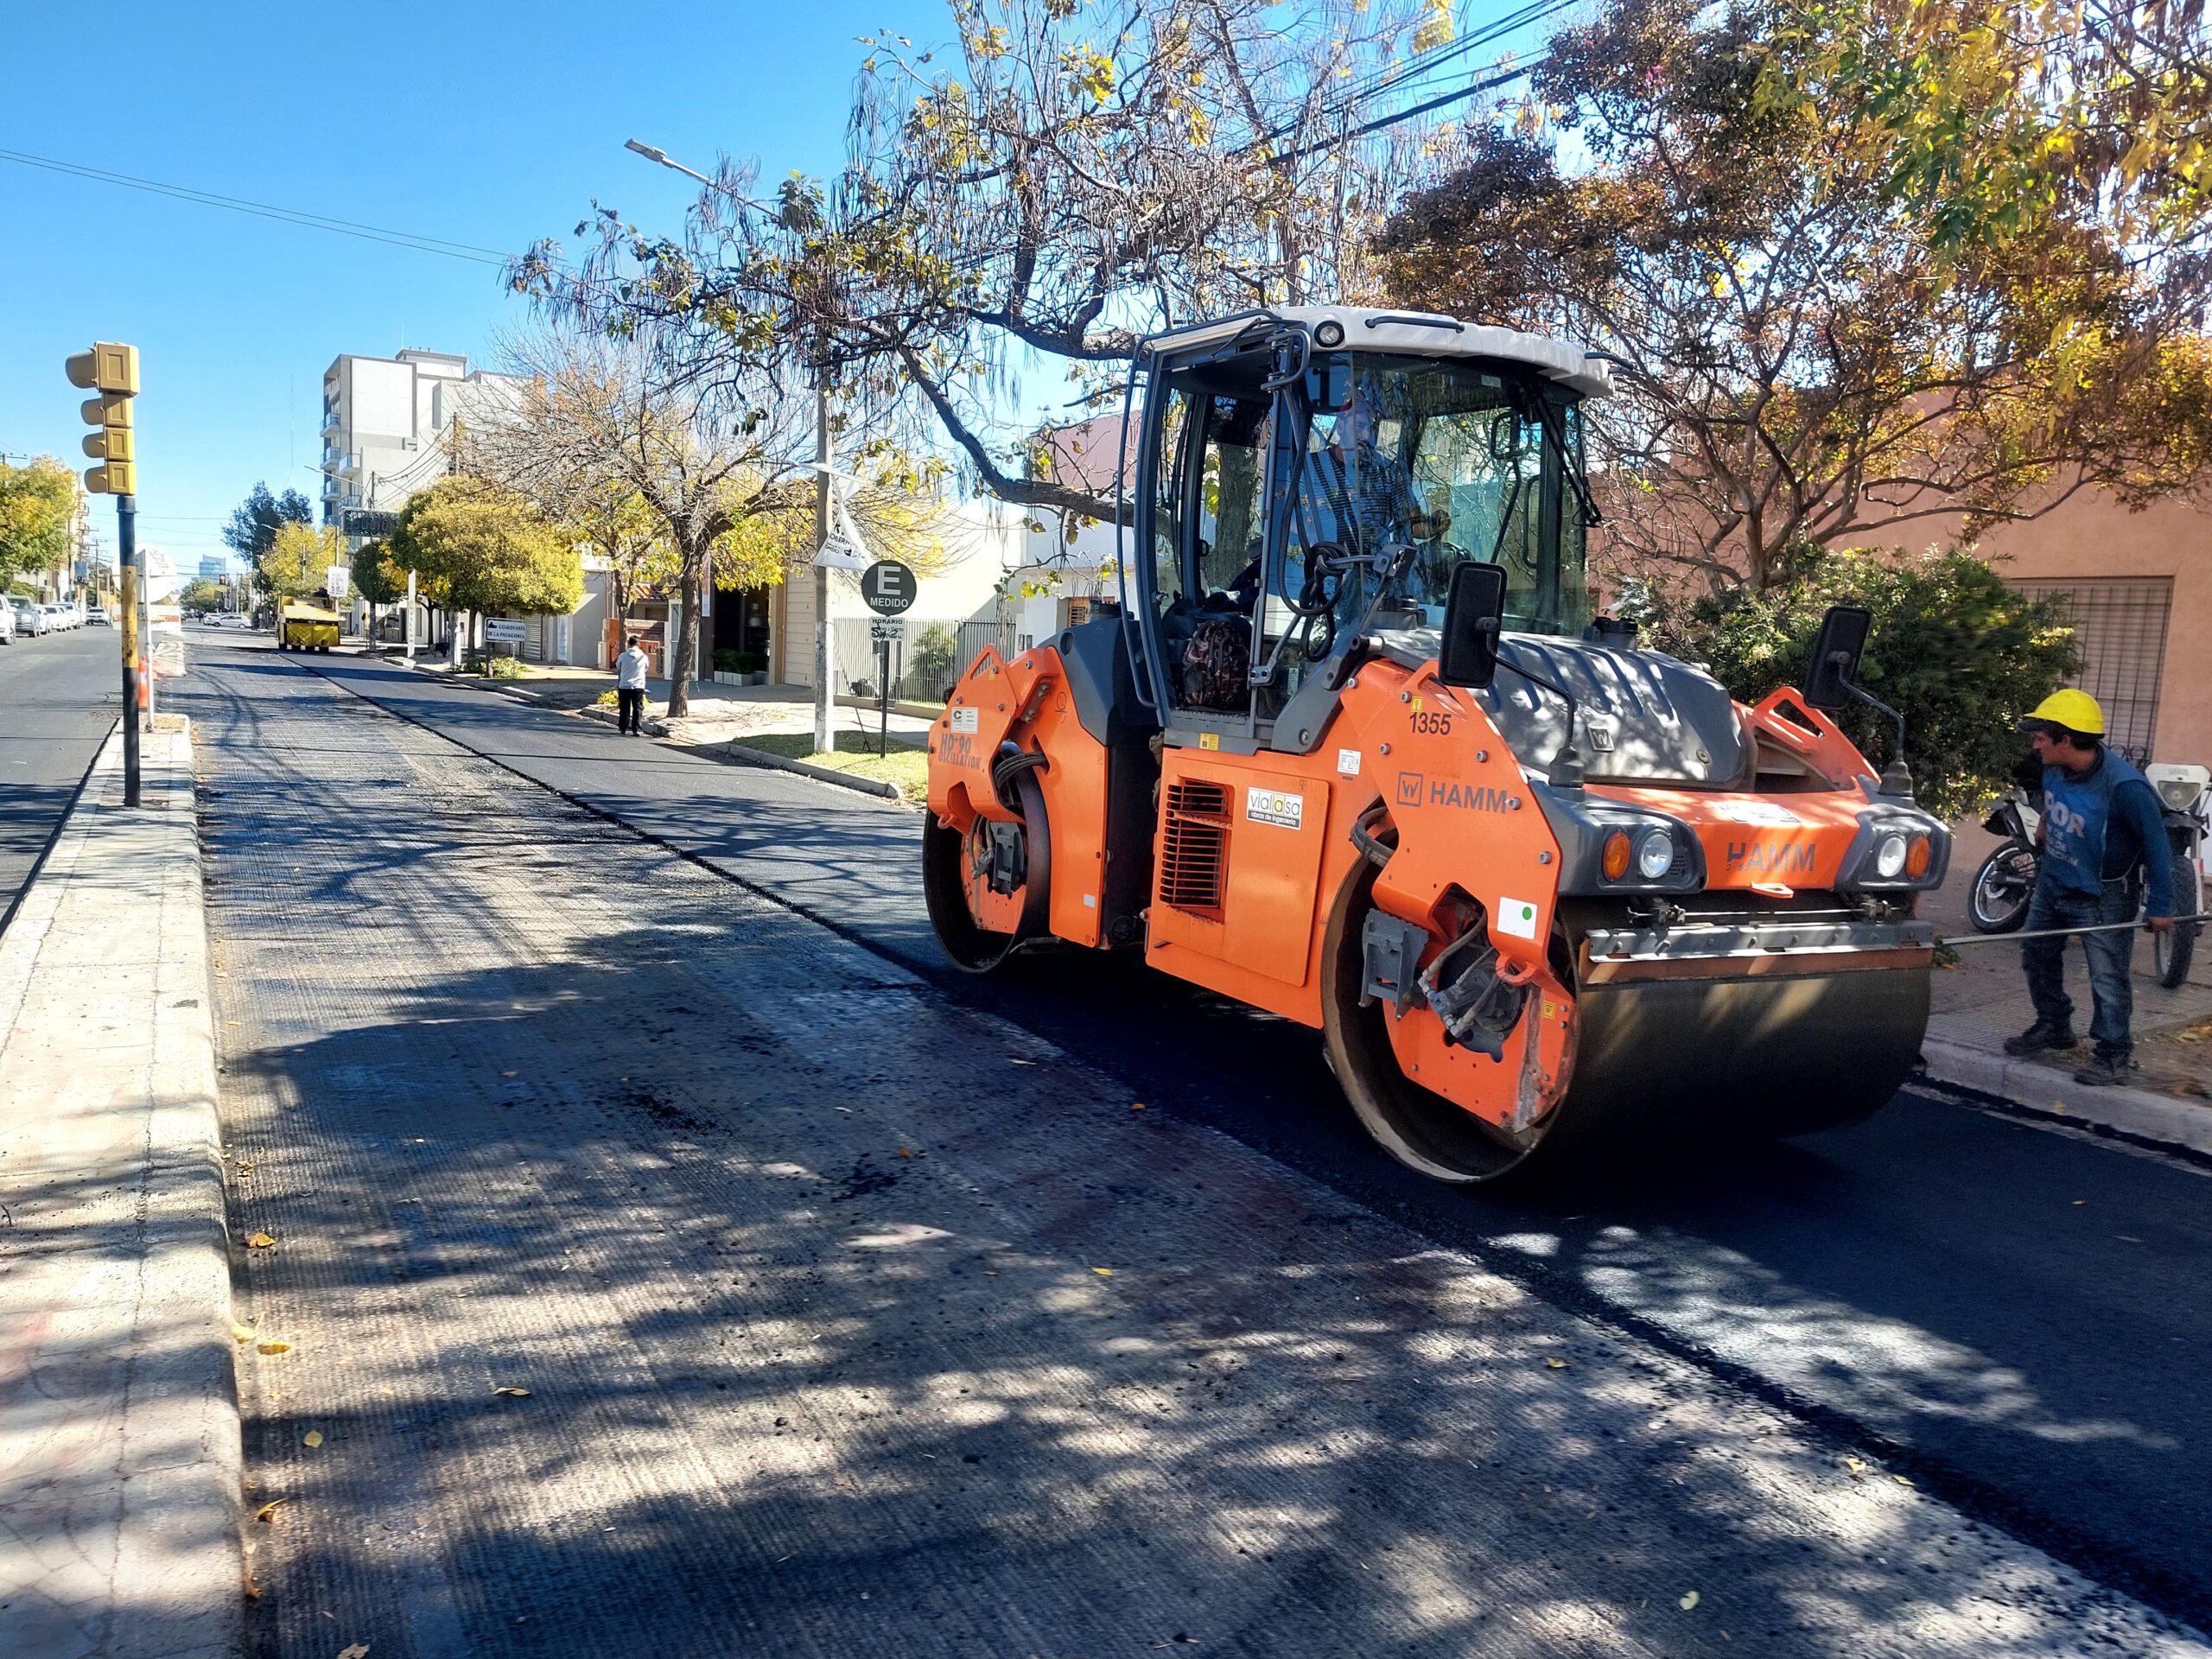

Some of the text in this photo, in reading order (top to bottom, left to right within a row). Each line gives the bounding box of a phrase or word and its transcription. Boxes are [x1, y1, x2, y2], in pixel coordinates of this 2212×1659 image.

[877, 566, 901, 595] E
[870, 597, 909, 608] MEDIDO
[1409, 711, 1452, 735] 1355
[938, 750, 982, 770] OSCILLATION
[1429, 780, 1508, 814] HAMM
[1726, 842, 1816, 872] HAMM
